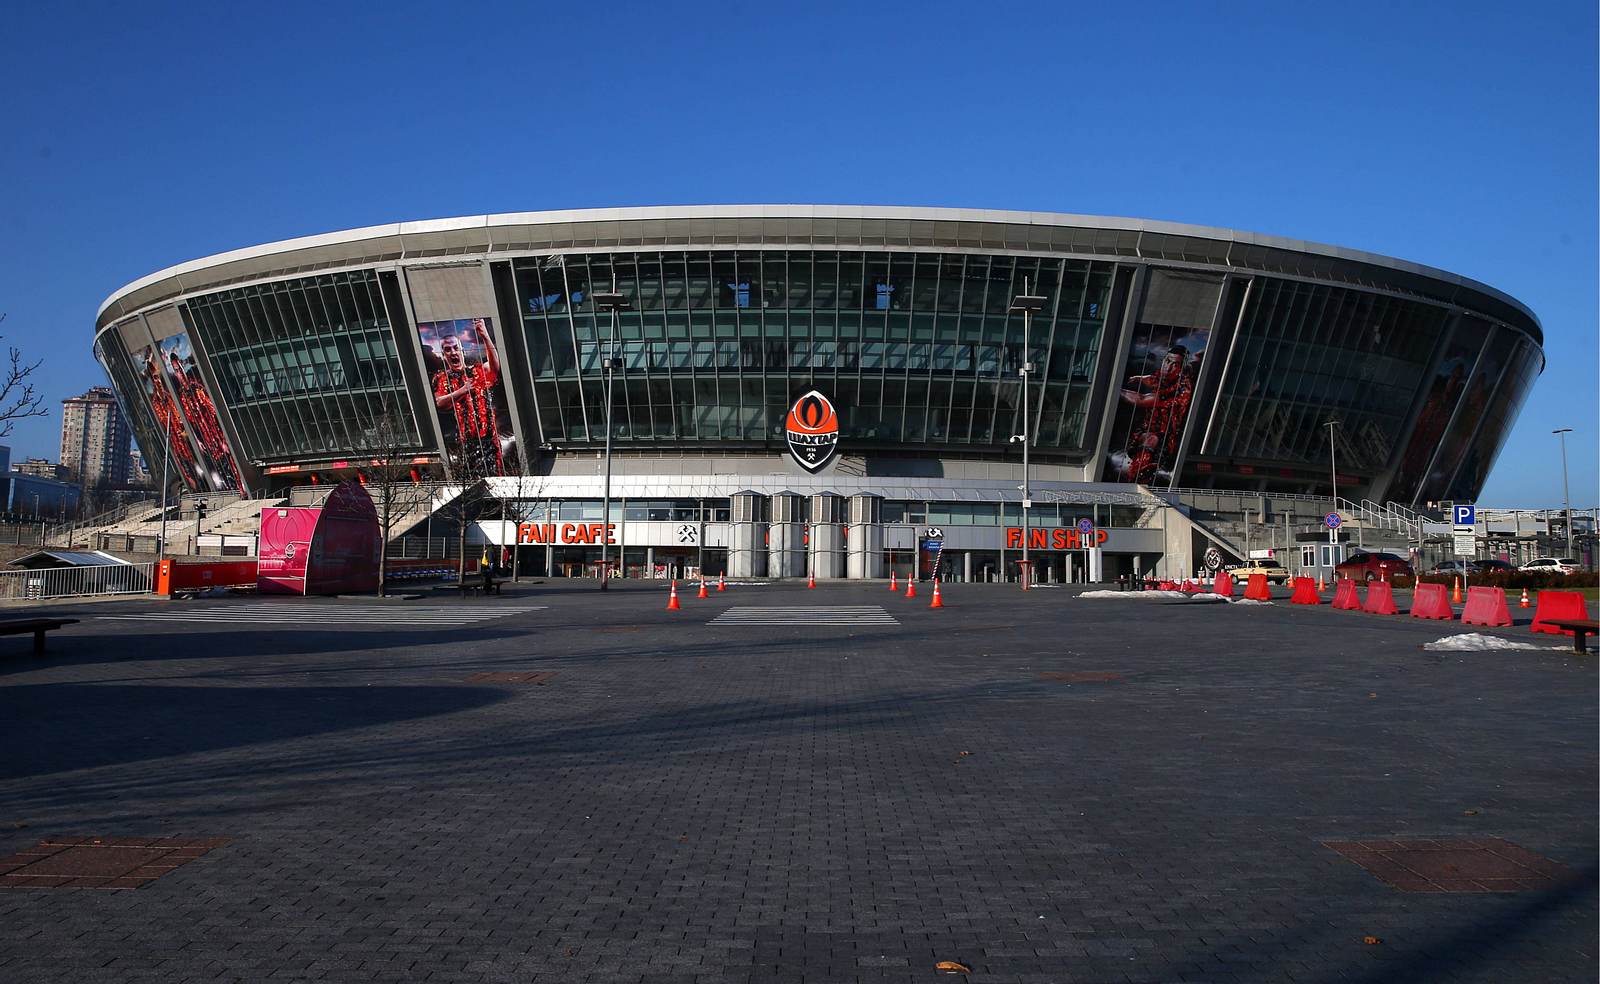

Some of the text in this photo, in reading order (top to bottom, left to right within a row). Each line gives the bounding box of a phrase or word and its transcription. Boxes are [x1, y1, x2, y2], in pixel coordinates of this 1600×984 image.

[1458, 507, 1470, 523] P
[518, 524, 616, 544] FAN CAFE
[1007, 528, 1108, 549] FAN SHP
